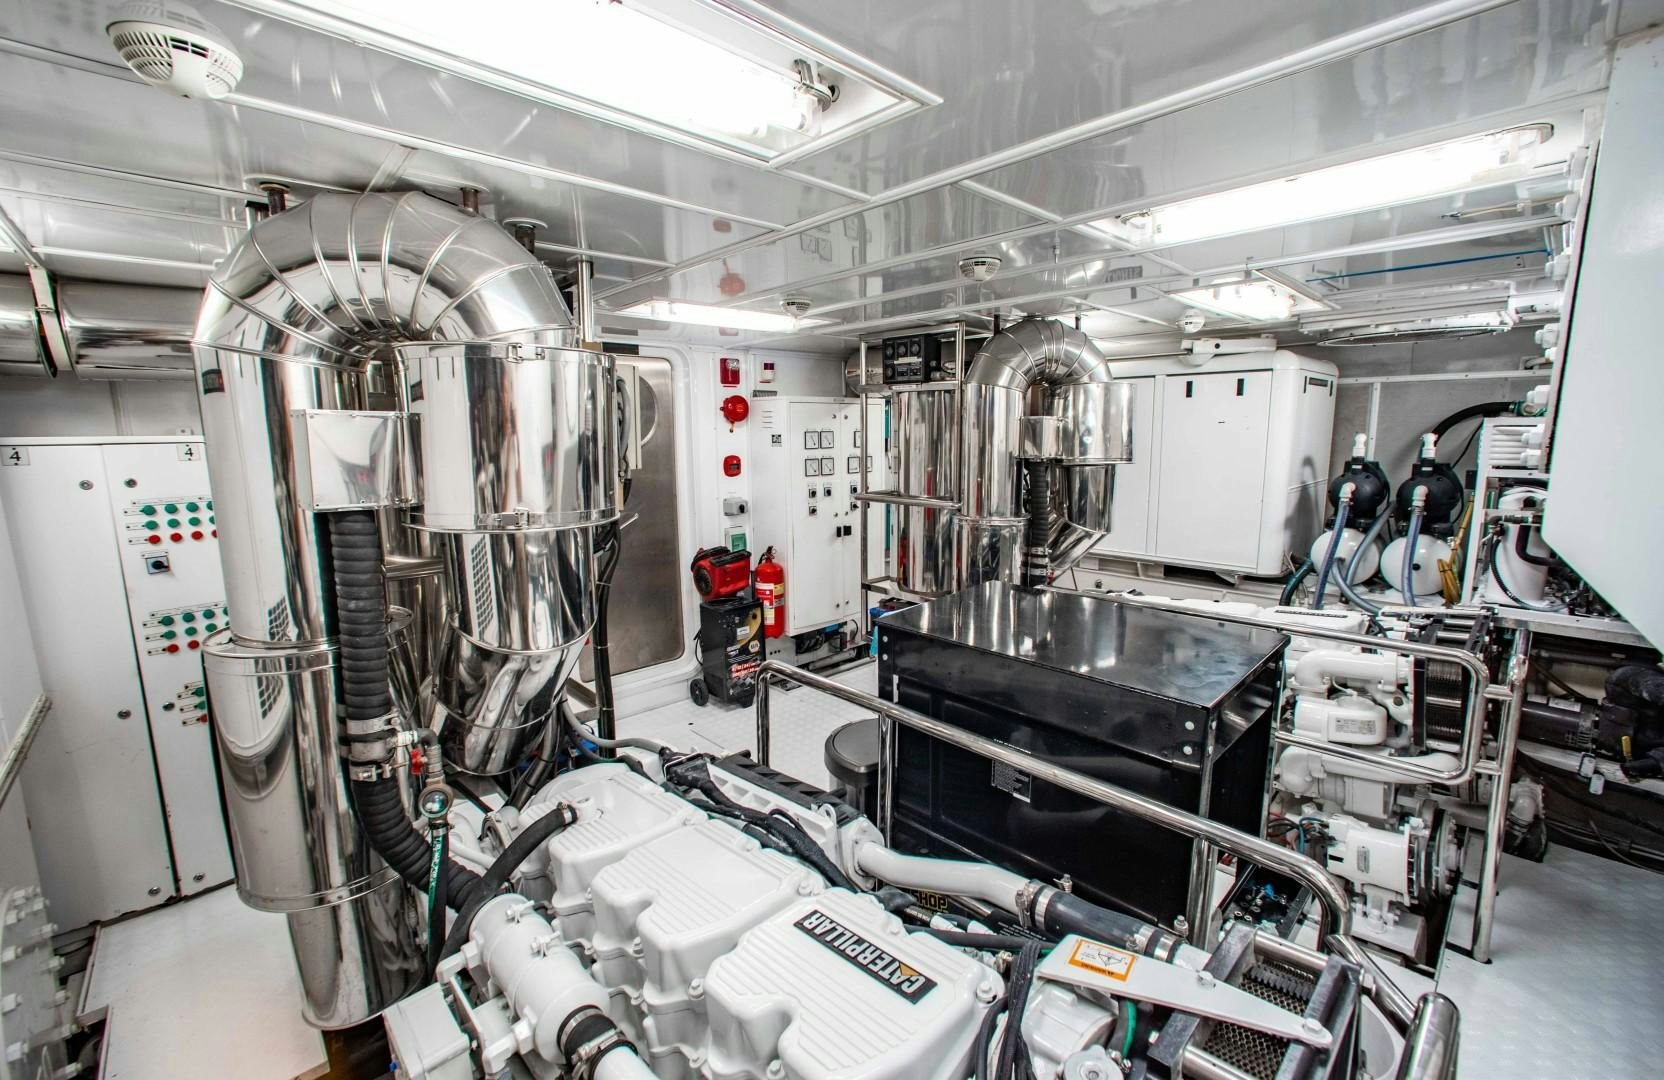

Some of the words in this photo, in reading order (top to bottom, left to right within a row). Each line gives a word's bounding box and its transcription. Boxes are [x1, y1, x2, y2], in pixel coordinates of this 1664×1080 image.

[9, 450, 21, 462] 4
[184, 447, 194, 457] 4
[803, 912, 926, 993] CATERPILLAR
